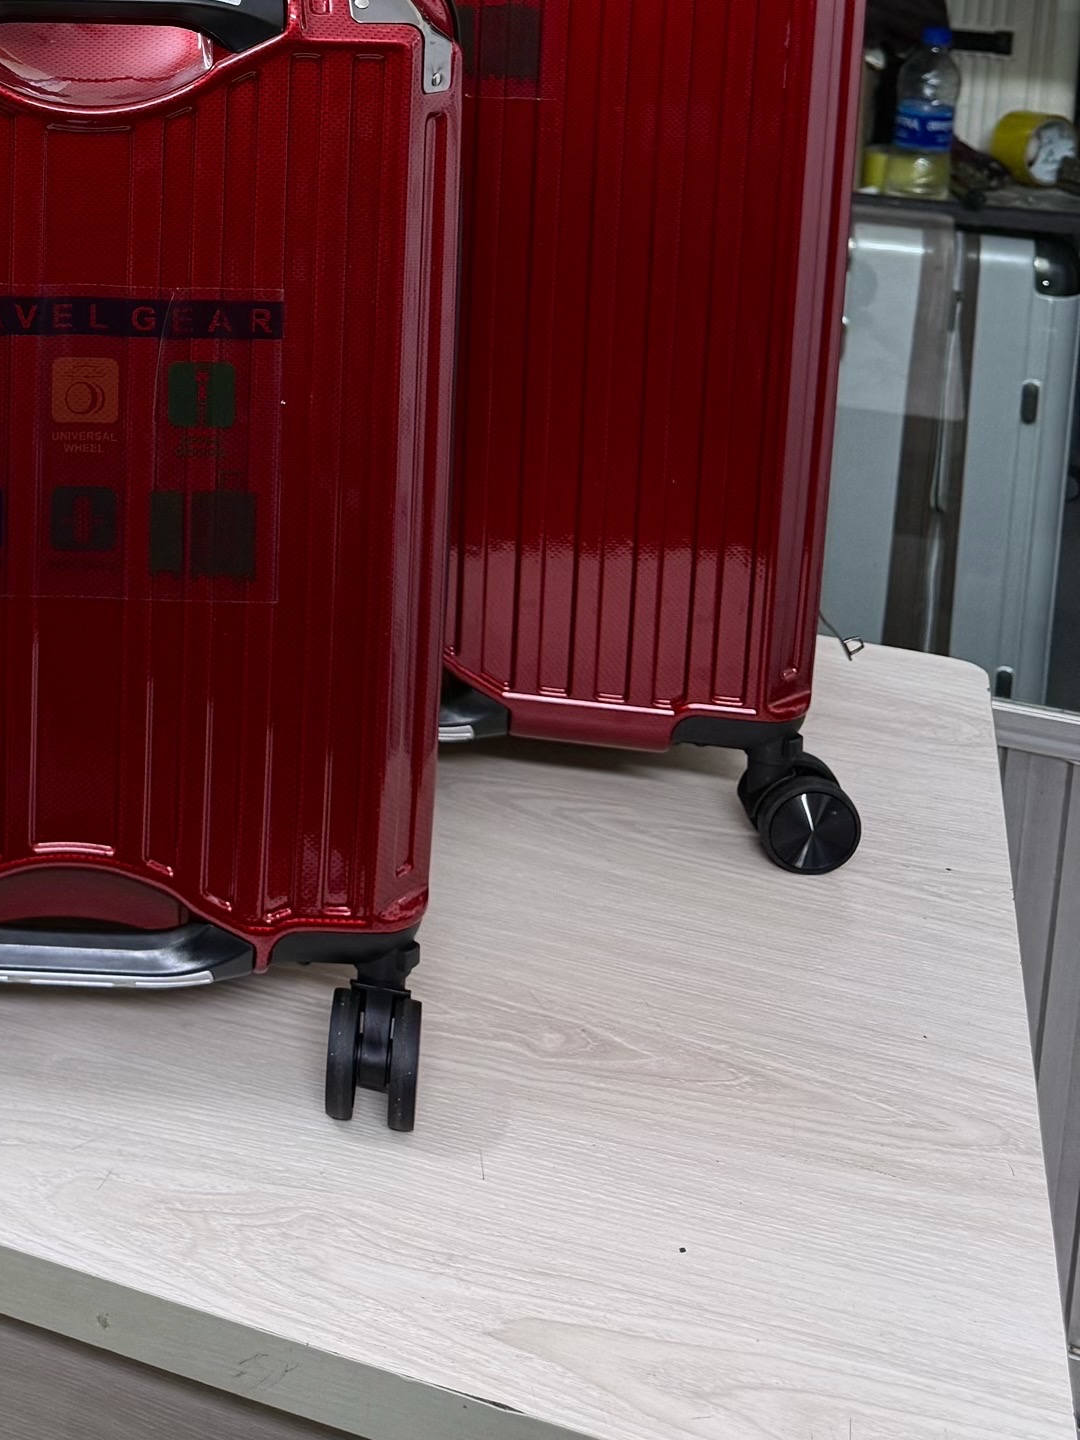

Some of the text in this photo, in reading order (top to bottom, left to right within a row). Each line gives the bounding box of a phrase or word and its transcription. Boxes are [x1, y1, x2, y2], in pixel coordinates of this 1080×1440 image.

[131, 305, 273, 335] GEAR
[51, 431, 118, 443] UNIVERSAL
[63, 443, 105, 454] WHEEL
